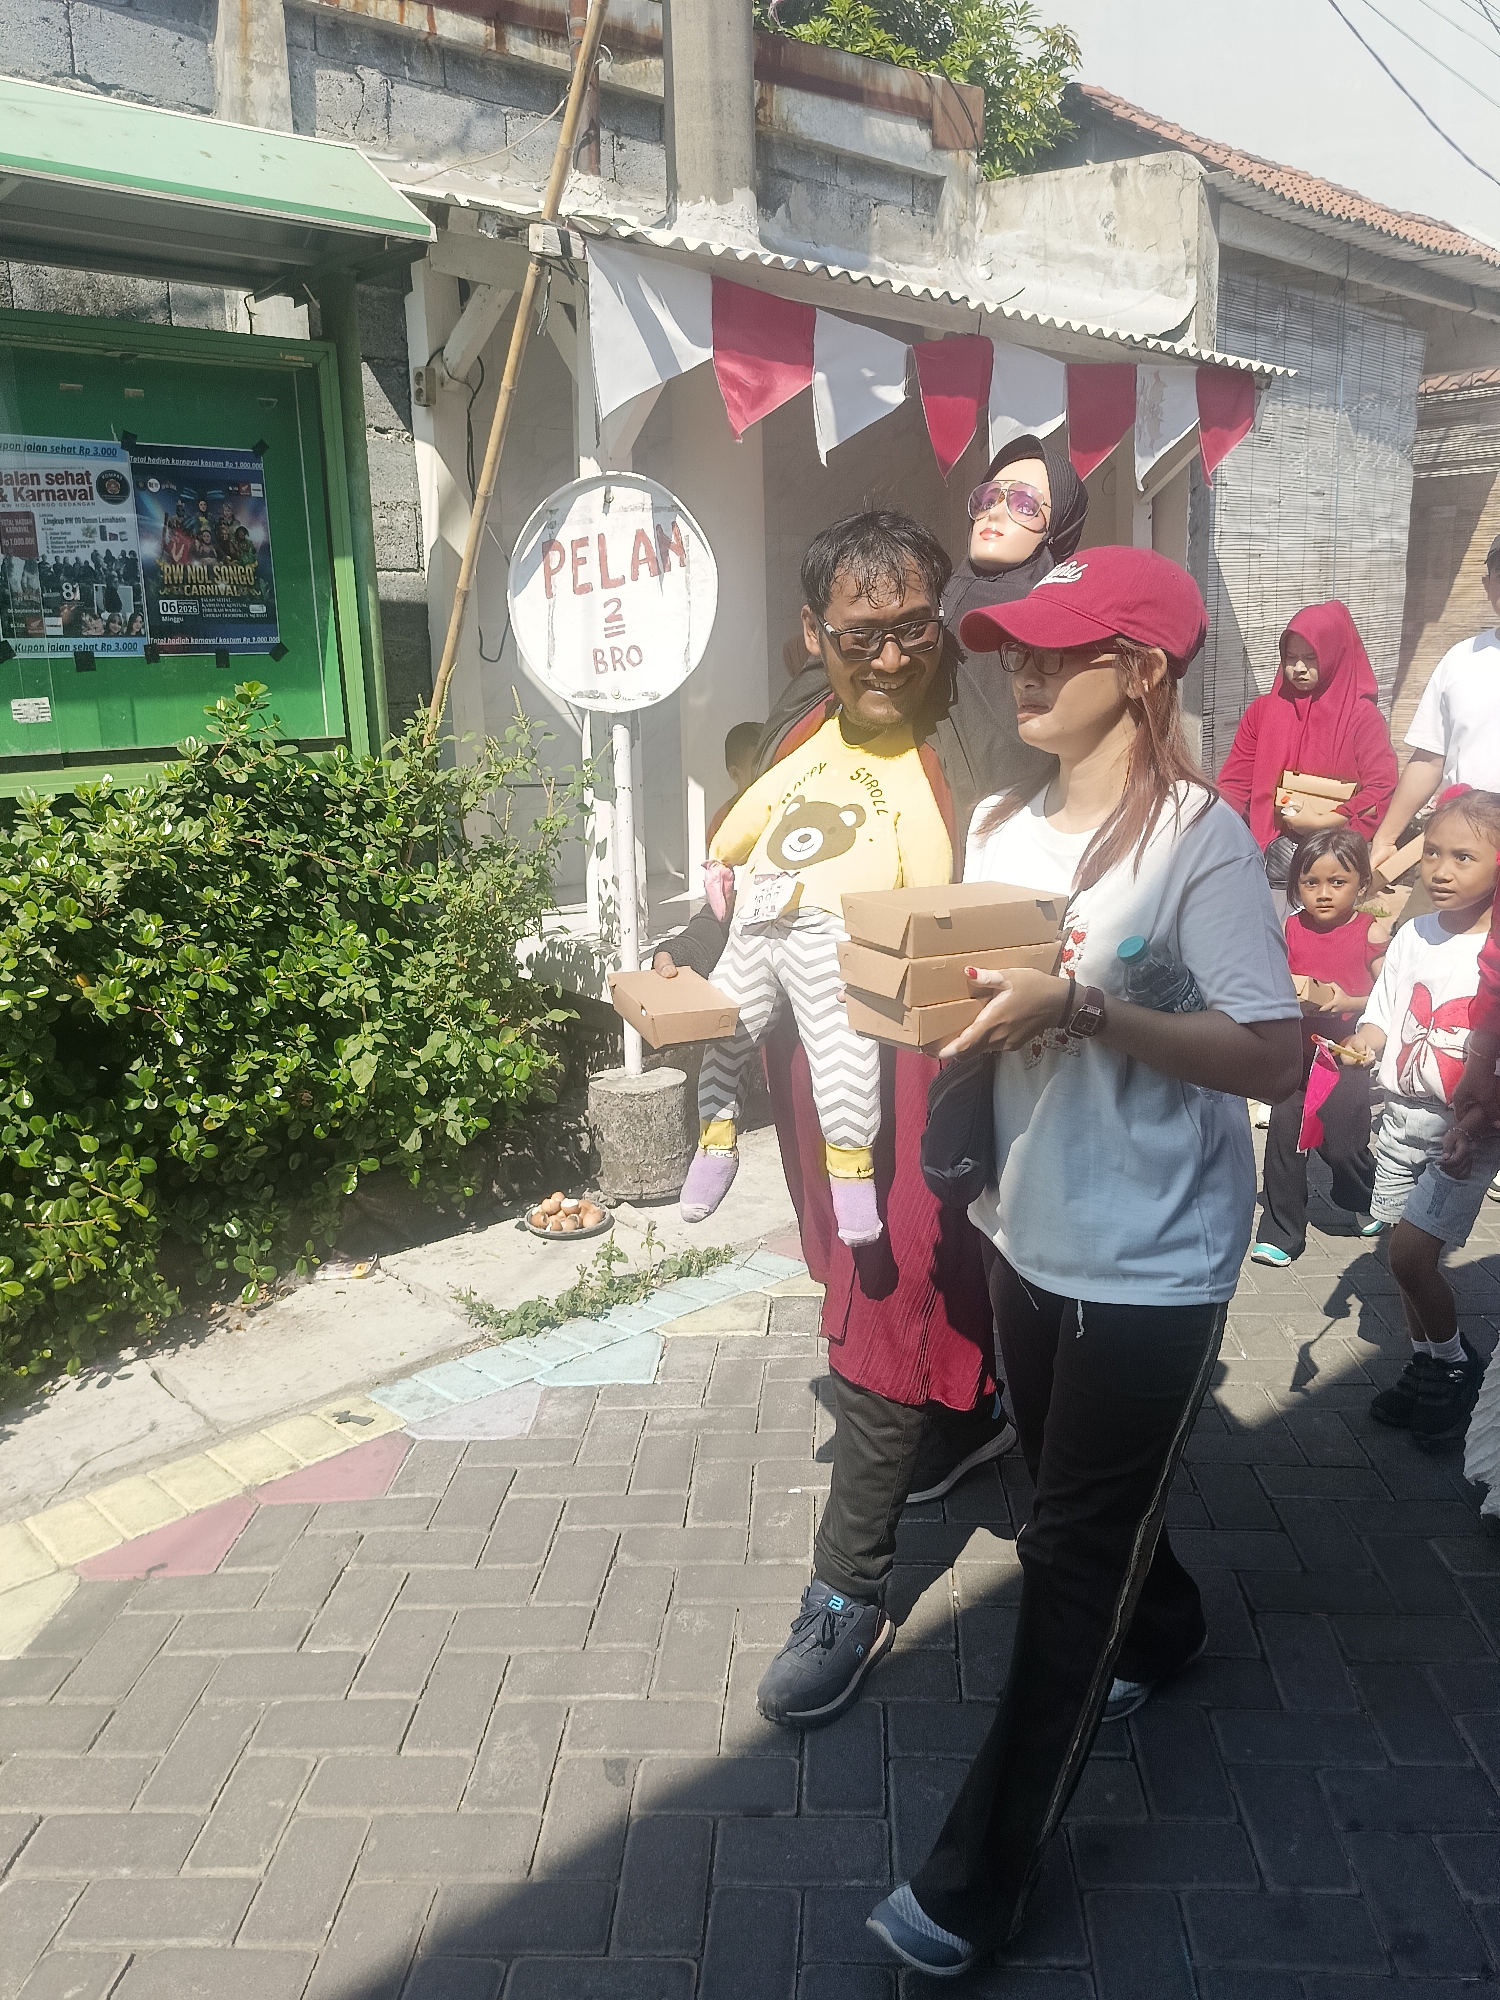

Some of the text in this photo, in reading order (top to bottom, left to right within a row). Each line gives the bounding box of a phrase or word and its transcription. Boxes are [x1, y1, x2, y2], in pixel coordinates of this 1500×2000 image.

[24, 442, 48, 453] jalan
[50, 444, 76, 454] sehat
[79, 445, 91, 457] Rp
[92, 446, 118, 457] 3.000
[45, 470, 92, 486] sehat
[13, 486, 94, 502] Karnaval
[163, 564, 255, 586] RW NOL SONGO
[62, 582, 80, 601] 81
[184, 584, 241, 597] CARNIVAL
[161, 601, 177, 613] 06
[179, 605, 198, 613] 2026
[603, 597, 624, 624] 2
[161, 616, 184, 624] Minggu
[15, 642, 138, 654] Kupon jalan sehat Rp 3.000
[592, 645, 644, 675] BRO
[849, 767, 889, 816] STROLL
